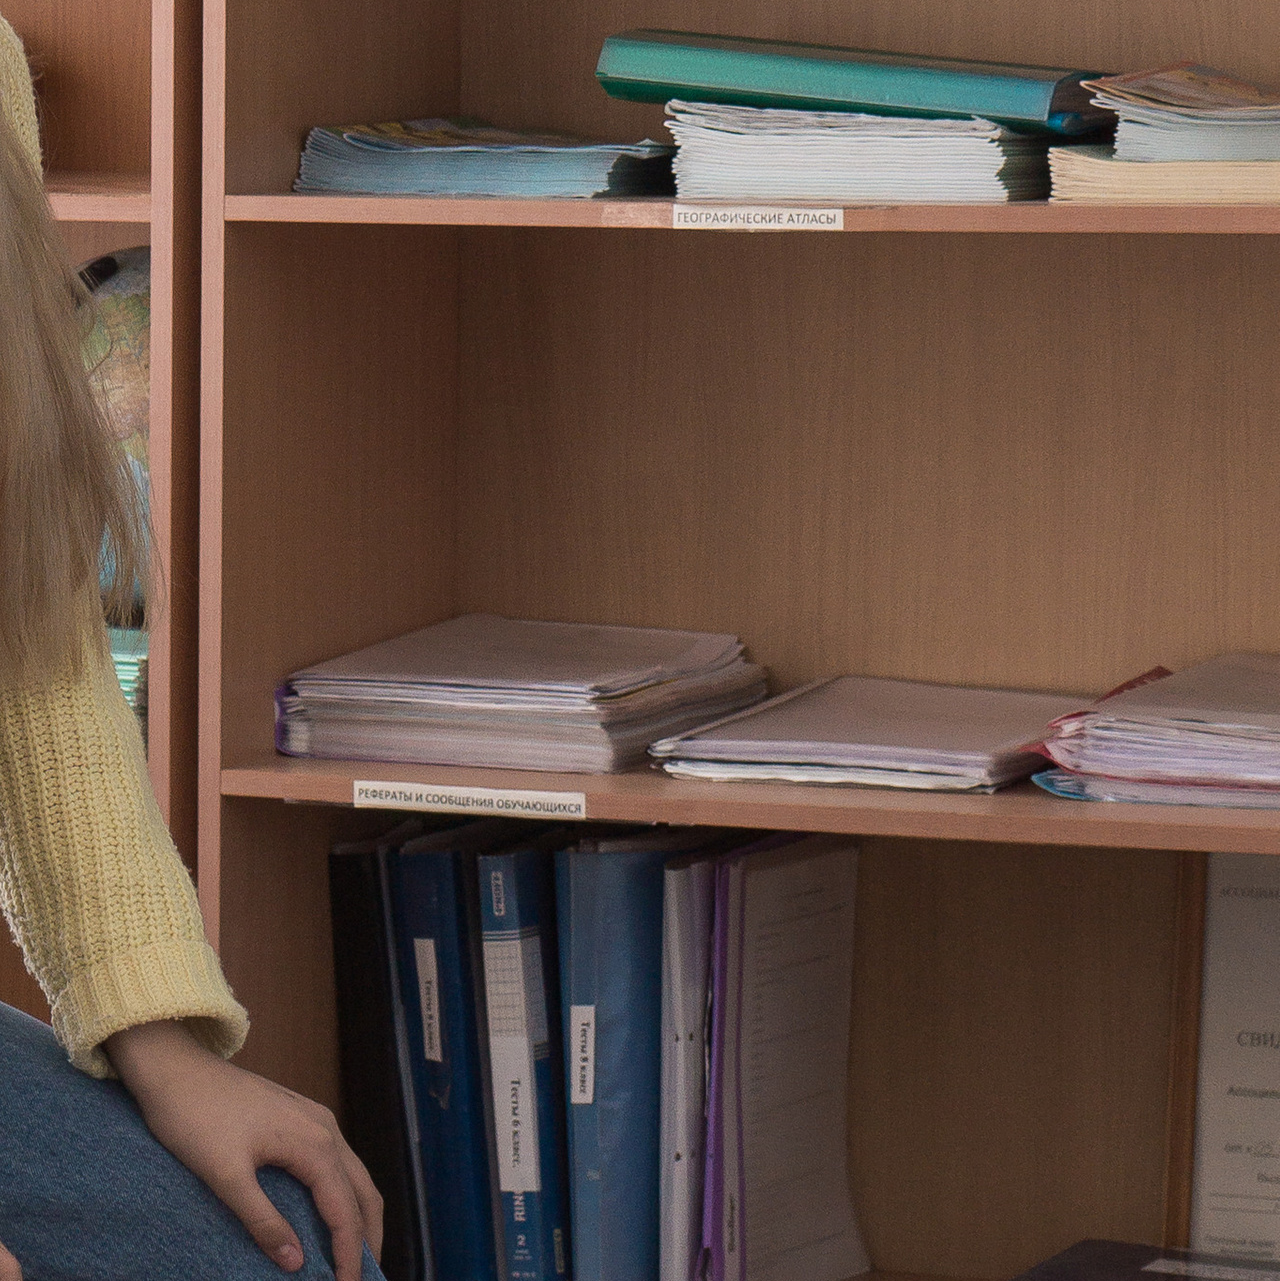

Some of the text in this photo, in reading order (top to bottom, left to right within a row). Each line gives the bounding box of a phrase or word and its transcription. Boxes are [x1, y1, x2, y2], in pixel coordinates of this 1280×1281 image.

[677, 212, 836, 225] ГЕОГРАФИЧЕСКИЕ АТЛАСЫ
[358, 788, 582, 814] РЕФЕРАТЫ И СООБЩЕНИЯ ОБУЧАЮЩИХСЯ
[577, 1021, 593, 1095] Тесты класс
[508, 1078, 523, 1117] Тесты
